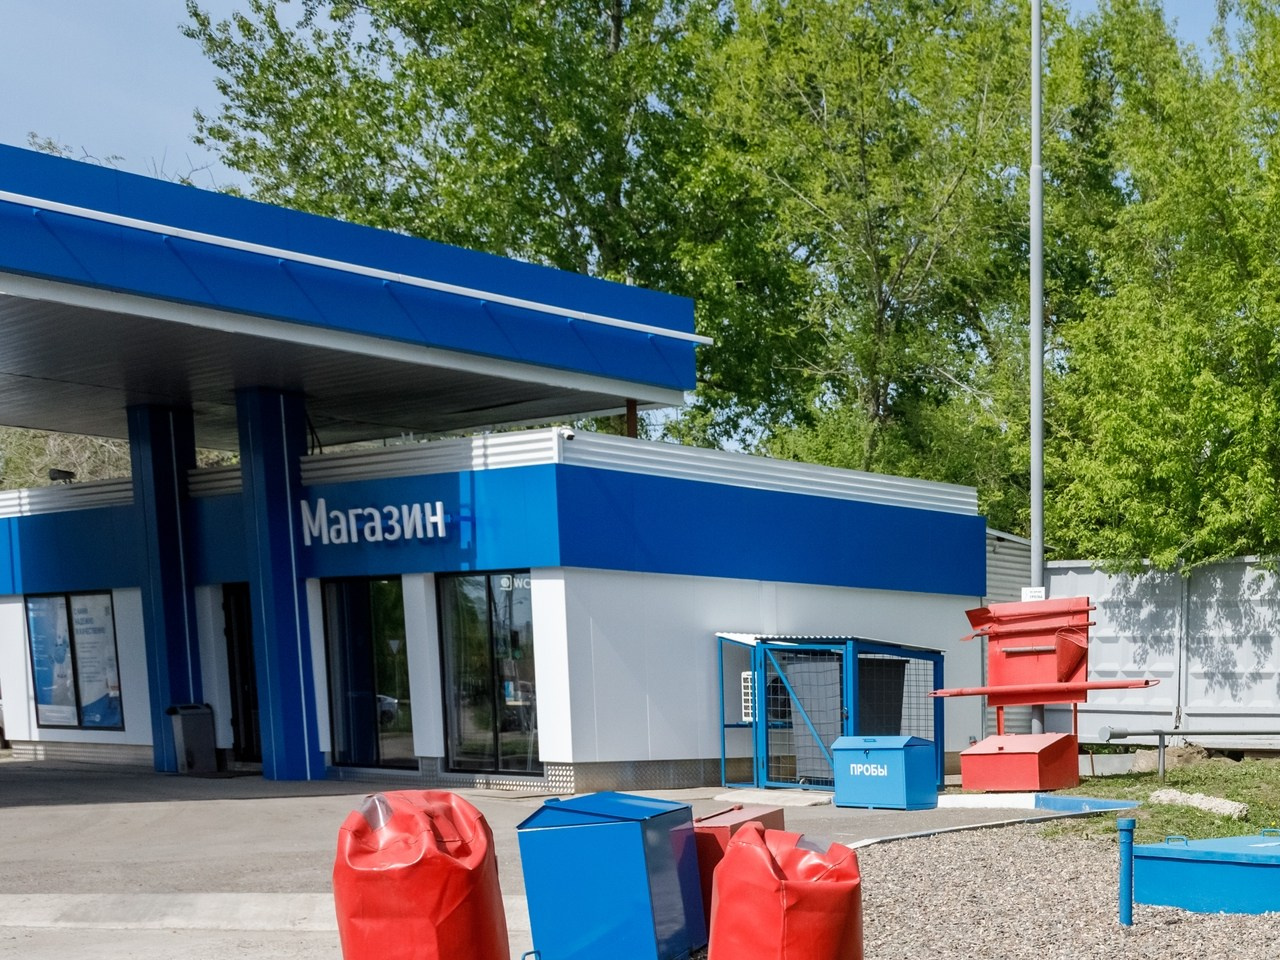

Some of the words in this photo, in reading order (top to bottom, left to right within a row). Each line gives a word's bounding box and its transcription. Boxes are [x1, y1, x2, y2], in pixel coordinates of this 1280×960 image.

[300, 498, 447, 546] Магазин
[513, 577, 530, 589] WC
[850, 763, 888, 776] ПРОБЫ
